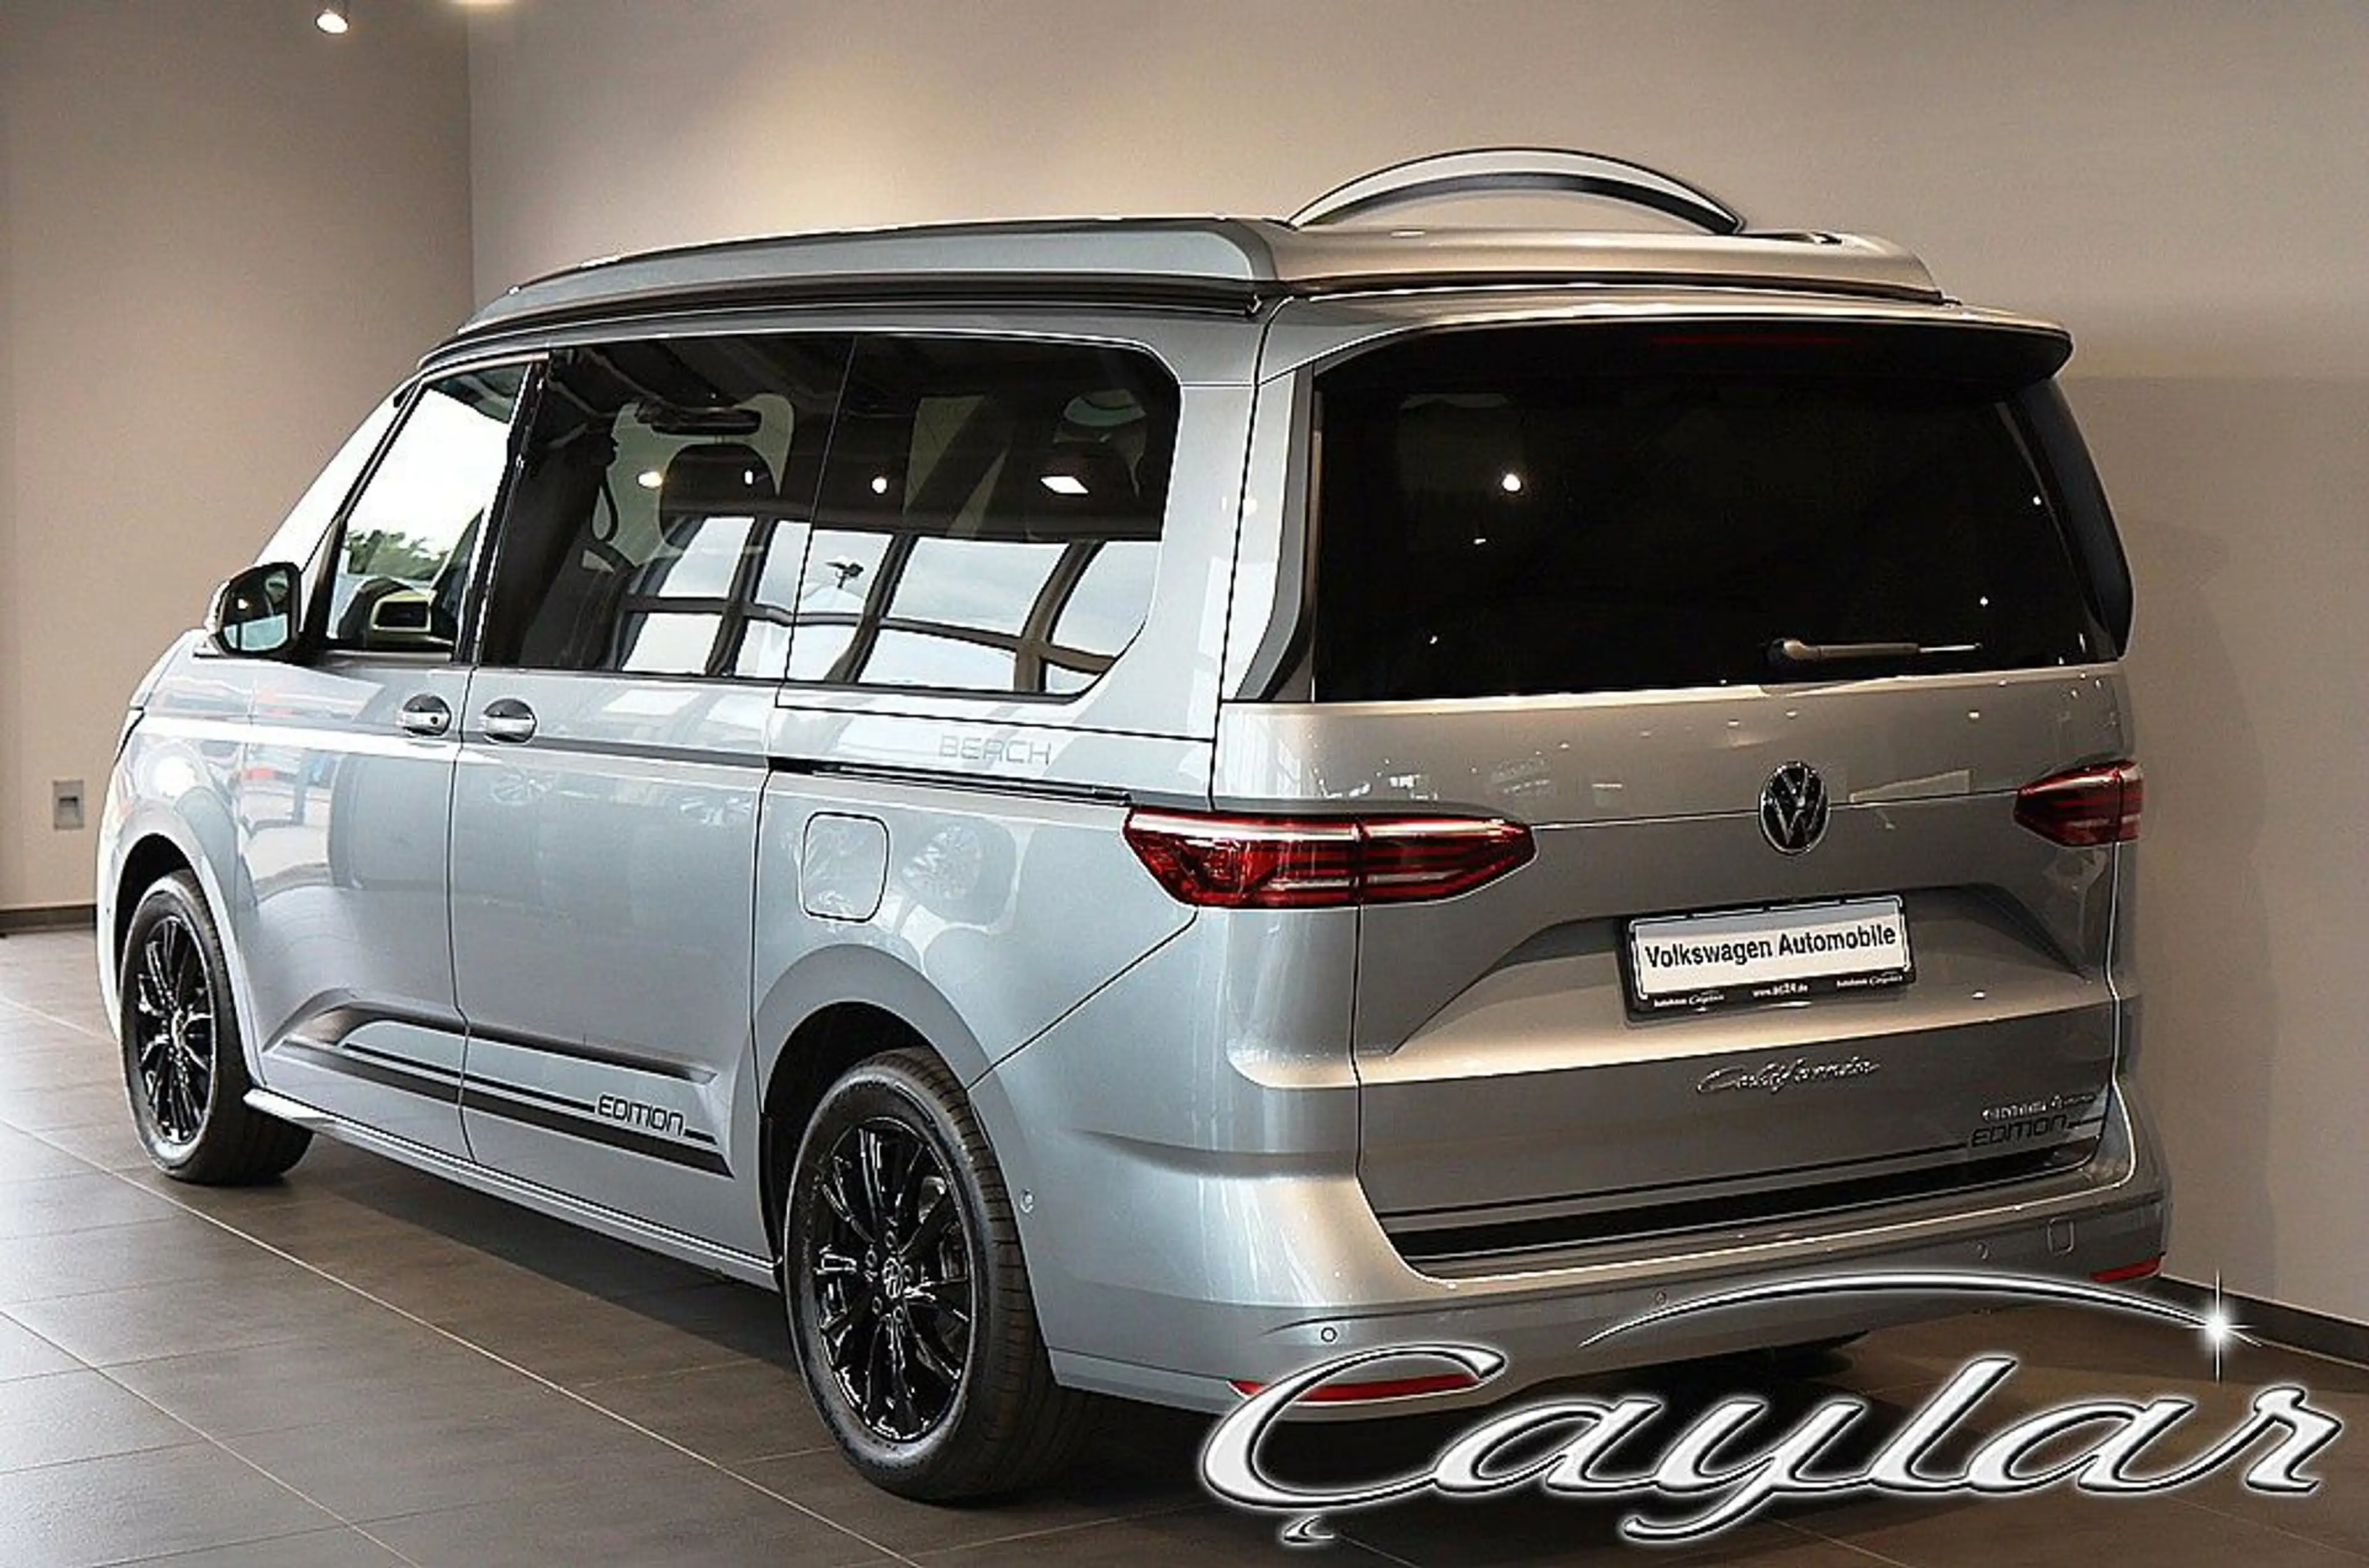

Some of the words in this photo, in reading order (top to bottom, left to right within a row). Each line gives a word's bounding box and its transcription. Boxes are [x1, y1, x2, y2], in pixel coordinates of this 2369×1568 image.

[939, 734, 1051, 765] BEACH
[1645, 939, 1772, 968] Volkswagen
[1778, 925, 1896, 956] Automobile
